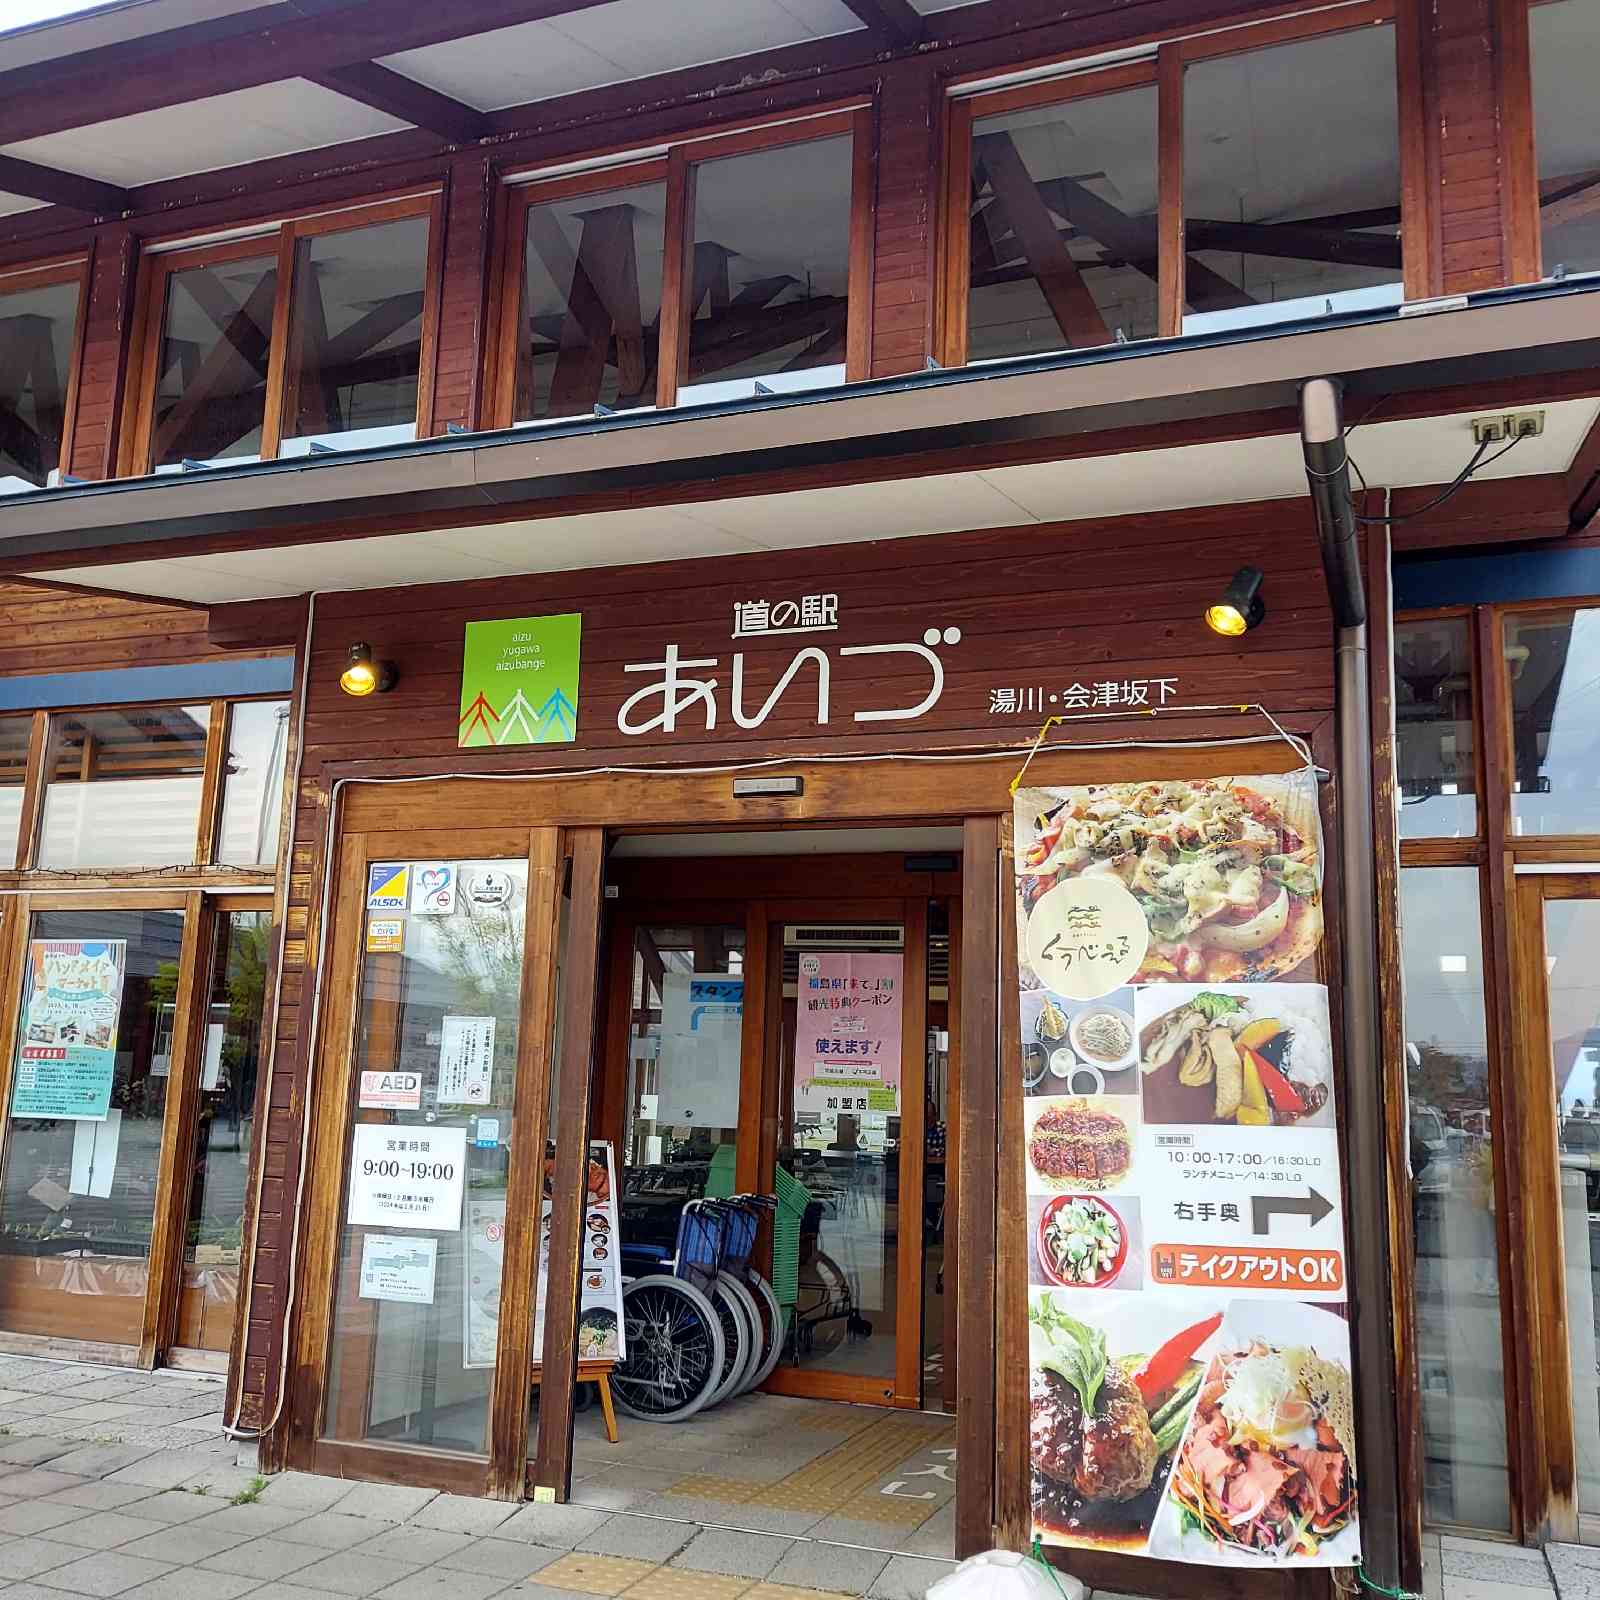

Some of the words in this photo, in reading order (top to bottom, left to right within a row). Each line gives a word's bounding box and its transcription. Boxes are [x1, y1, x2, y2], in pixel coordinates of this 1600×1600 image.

[731, 593, 838, 639] 道の駅
[512, 632, 532, 642] aizu
[503, 643, 540, 658] yugawa
[495, 658, 545, 672] aizubange
[617, 627, 961, 735] あいづ
[988, 677, 1179, 714] 湯川・会津坂下
[369, 897, 403, 907] ALSOK
[380, 1075, 417, 1090] AED
[827, 1096, 867, 1110] 加盟店
[386, 1139, 431, 1153] 営業時間
[1173, 1201, 1240, 1223] 右手奥
[1178, 1251, 1338, 1283] テイクアウトOK
